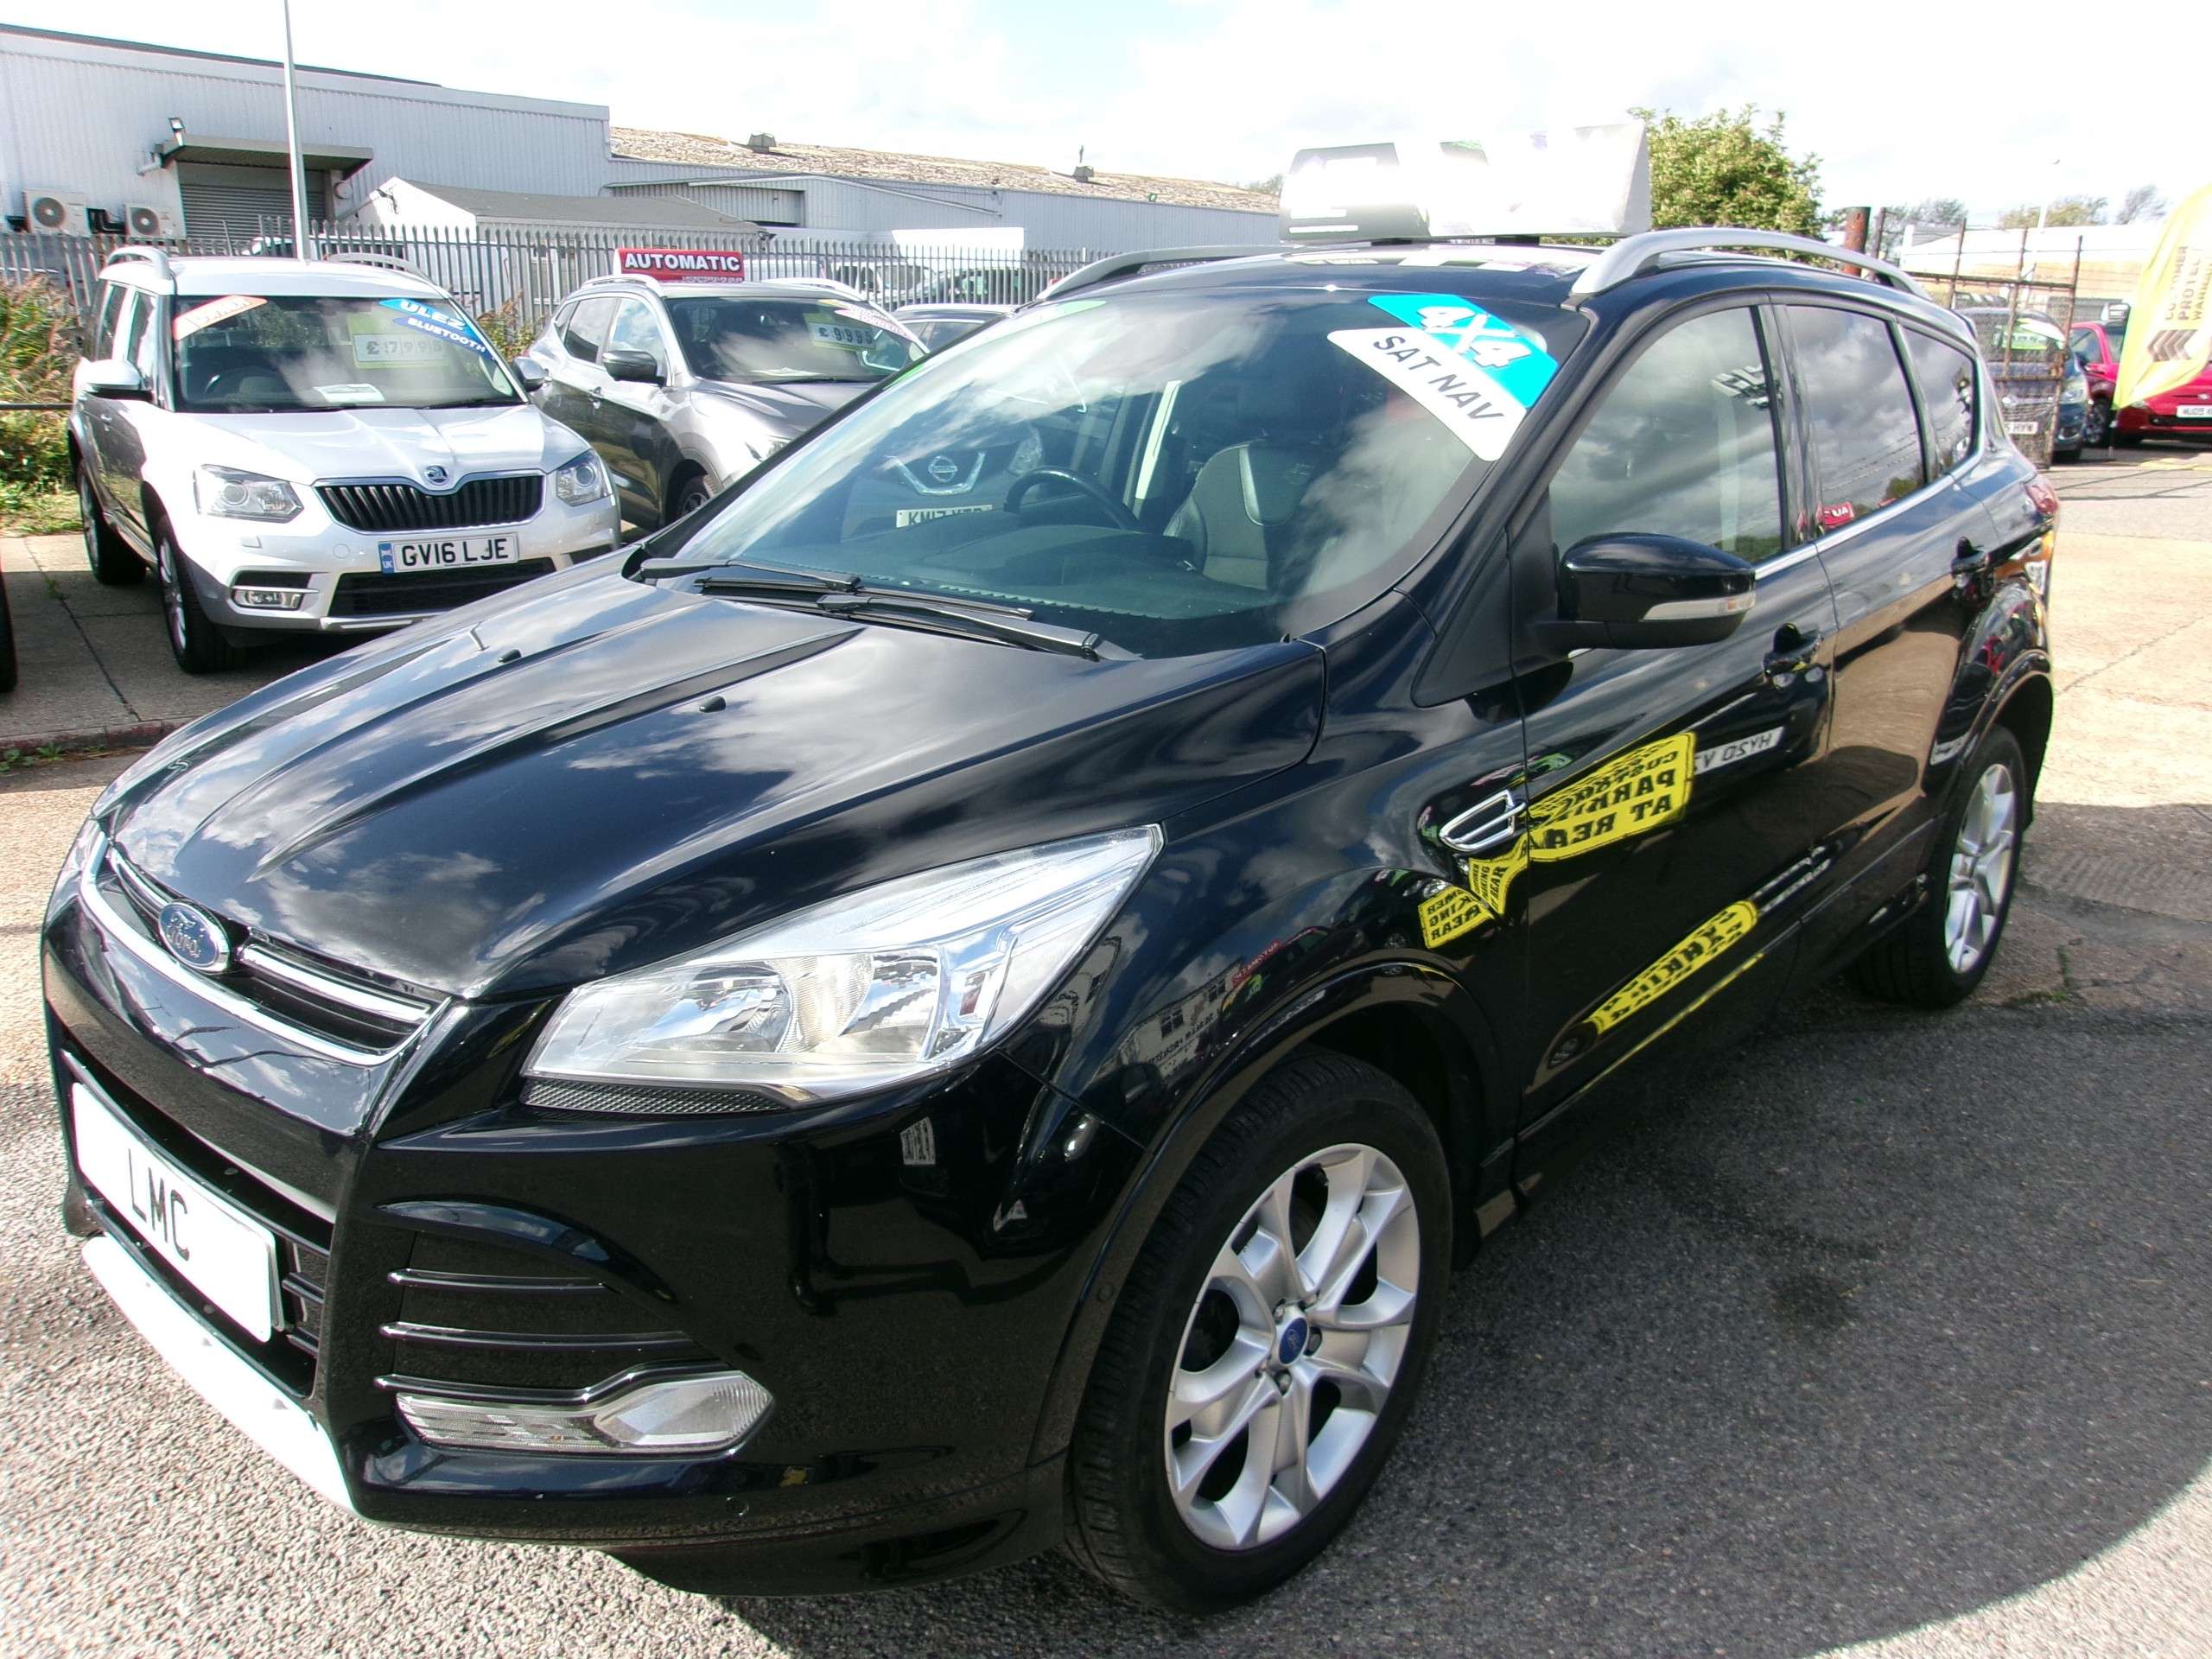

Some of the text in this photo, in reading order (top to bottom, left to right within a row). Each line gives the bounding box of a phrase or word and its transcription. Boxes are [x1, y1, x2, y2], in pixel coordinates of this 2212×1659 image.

[624, 252, 741, 271] AUTOMATIC
[400, 300, 466, 330] ULEZ
[407, 317, 486, 353] BLUETOOTH
[1373, 335, 1505, 420] SAT NAV
[402, 537, 508, 567] GV16 LJE
[128, 1148, 190, 1262] LMC
